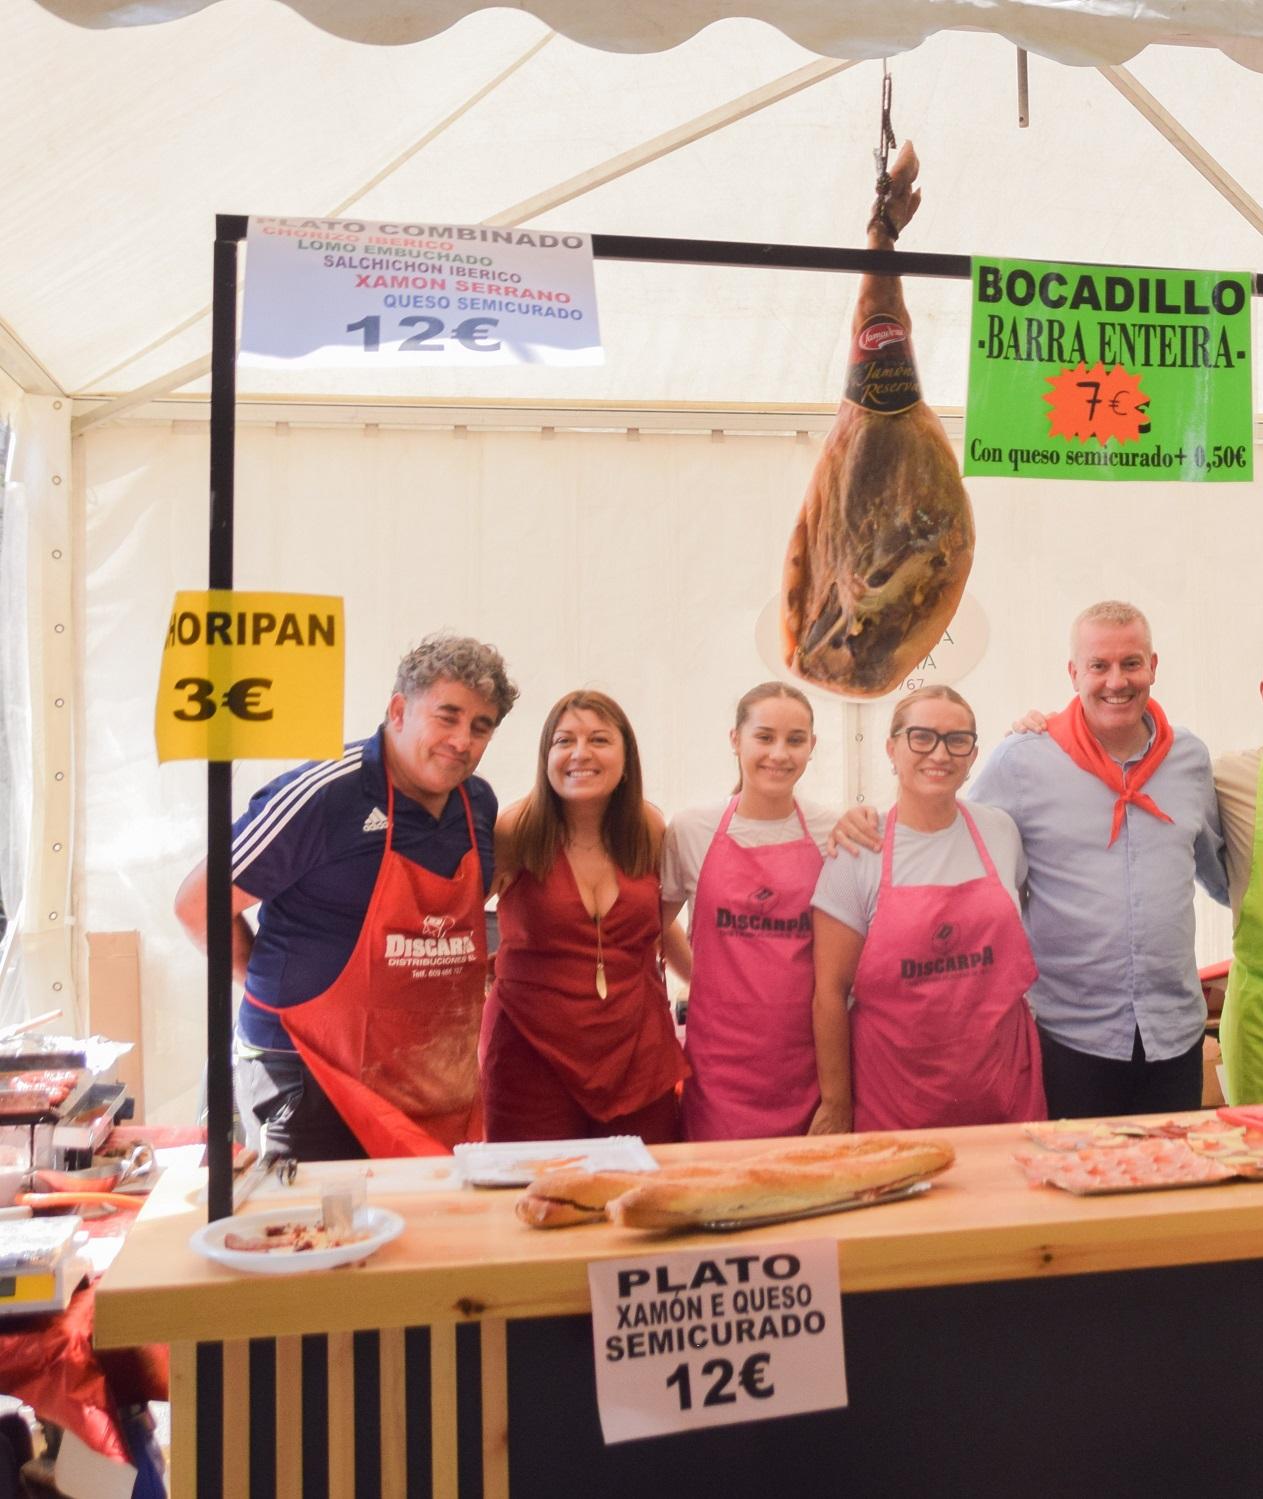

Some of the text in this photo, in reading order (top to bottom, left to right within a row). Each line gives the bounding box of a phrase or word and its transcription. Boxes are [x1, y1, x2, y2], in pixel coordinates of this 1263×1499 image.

[262, 227, 454, 252] CHORIZO IBERICO
[297, 239, 493, 267] LOMO EMBUCHADO
[378, 222, 584, 249] COMBINADO
[323, 254, 522, 284] SALCHICHON IBERICO
[355, 274, 571, 304] XAMON SERRANO
[384, 294, 583, 321] QUESO SEMICURADO
[978, 265, 1245, 315] BOCADILLO
[346, 315, 503, 353] 12€
[971, 438, 1003, 463] Con
[1008, 446, 1060, 472] queso
[1195, 445, 1247, 473] 0,50€
[164, 611, 336, 650] HORIPAN
[173, 677, 274, 722] 3€
[617, 1254, 801, 1298] PLATO
[617, 1283, 812, 1330] XAMÓN E QUESO
[605, 1310, 826, 1362] SEMICURADO
[666, 1352, 775, 1411] 12€
